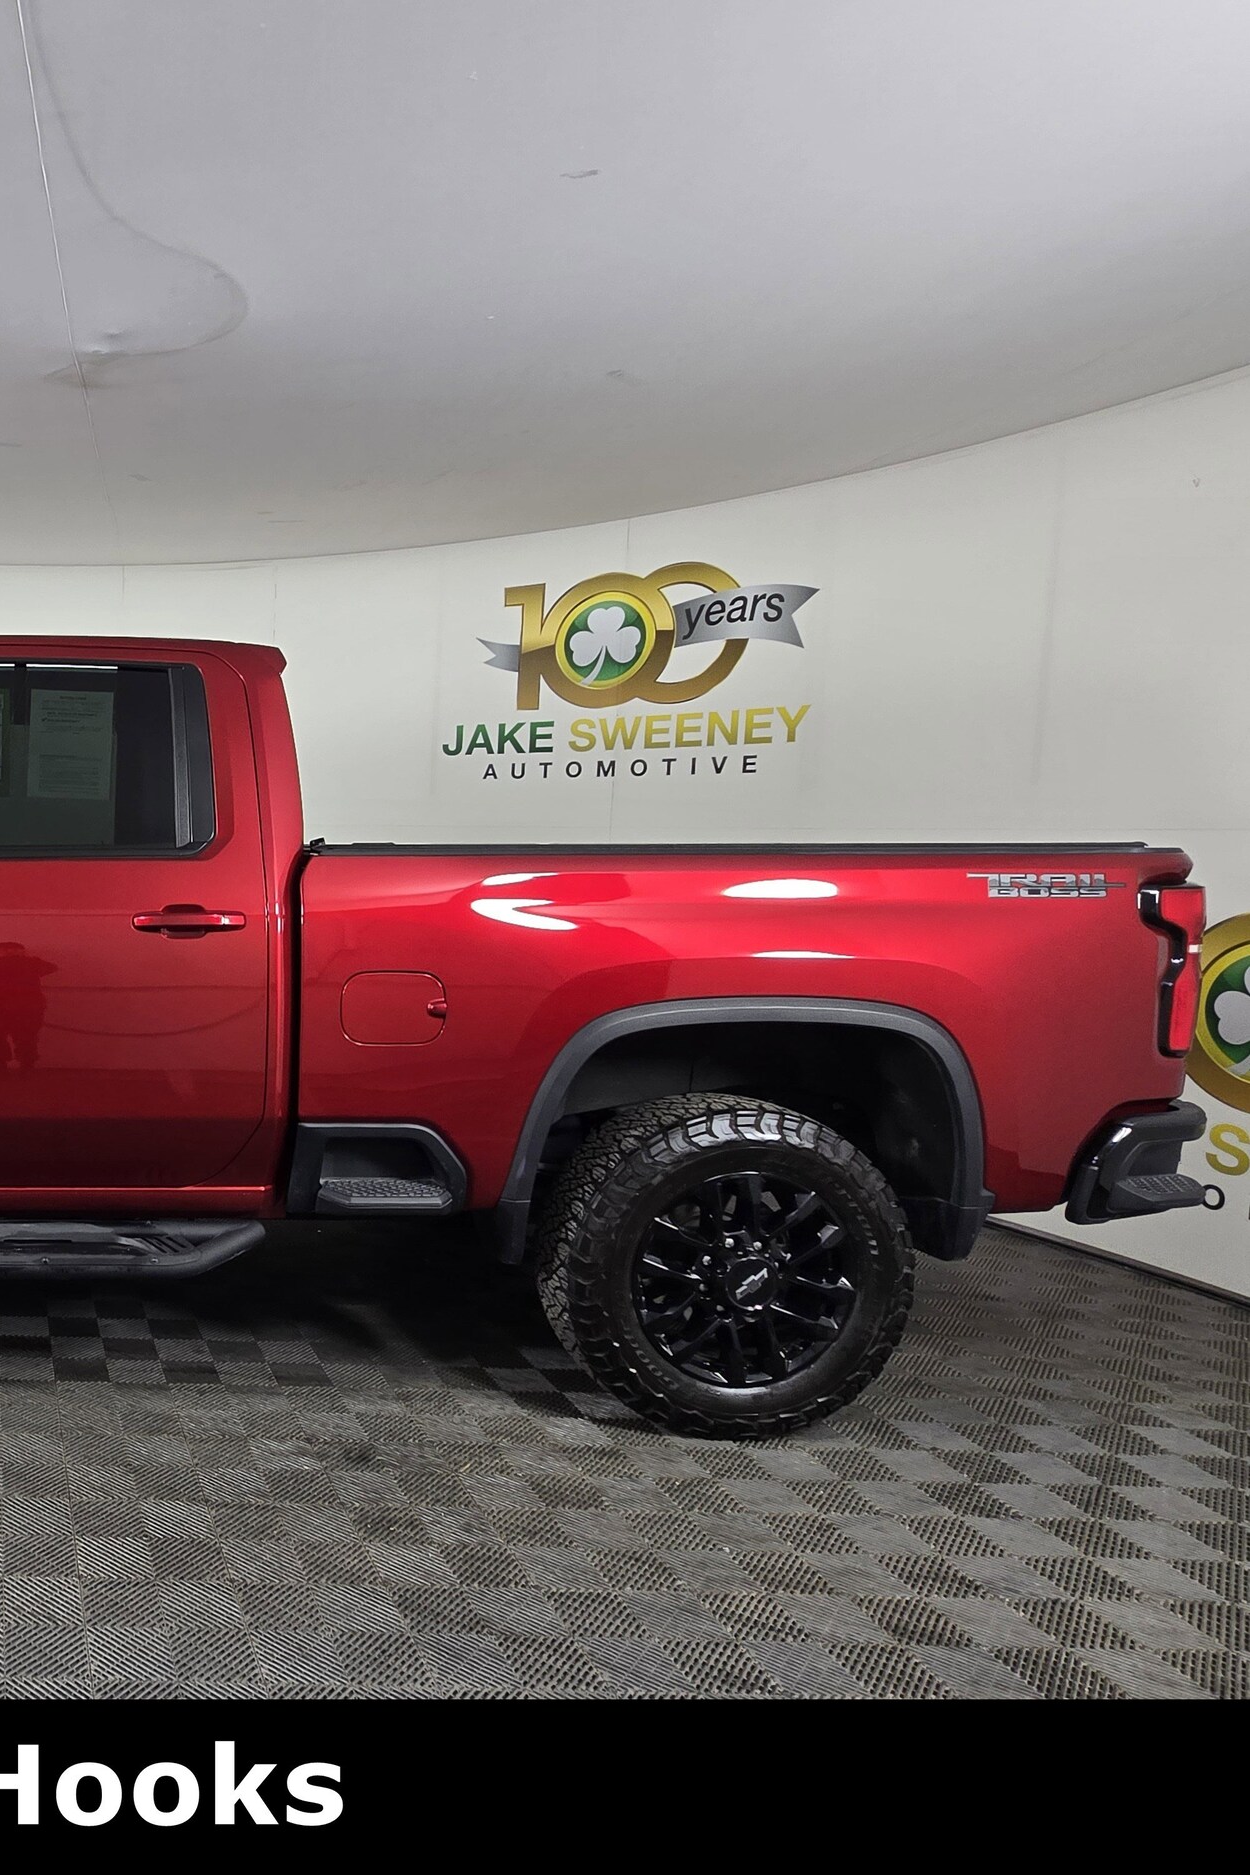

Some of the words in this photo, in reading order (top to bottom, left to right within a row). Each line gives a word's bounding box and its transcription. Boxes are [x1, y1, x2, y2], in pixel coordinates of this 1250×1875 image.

[682, 592, 785, 640] years
[504, 561, 749, 710] 100
[442, 720, 555, 756] JAKE
[568, 704, 811, 752] SWEENEY
[483, 755, 758, 780] AUTOMOTIVE
[966, 873, 1126, 887] TRAIL
[988, 886, 1107, 898] BOSS
